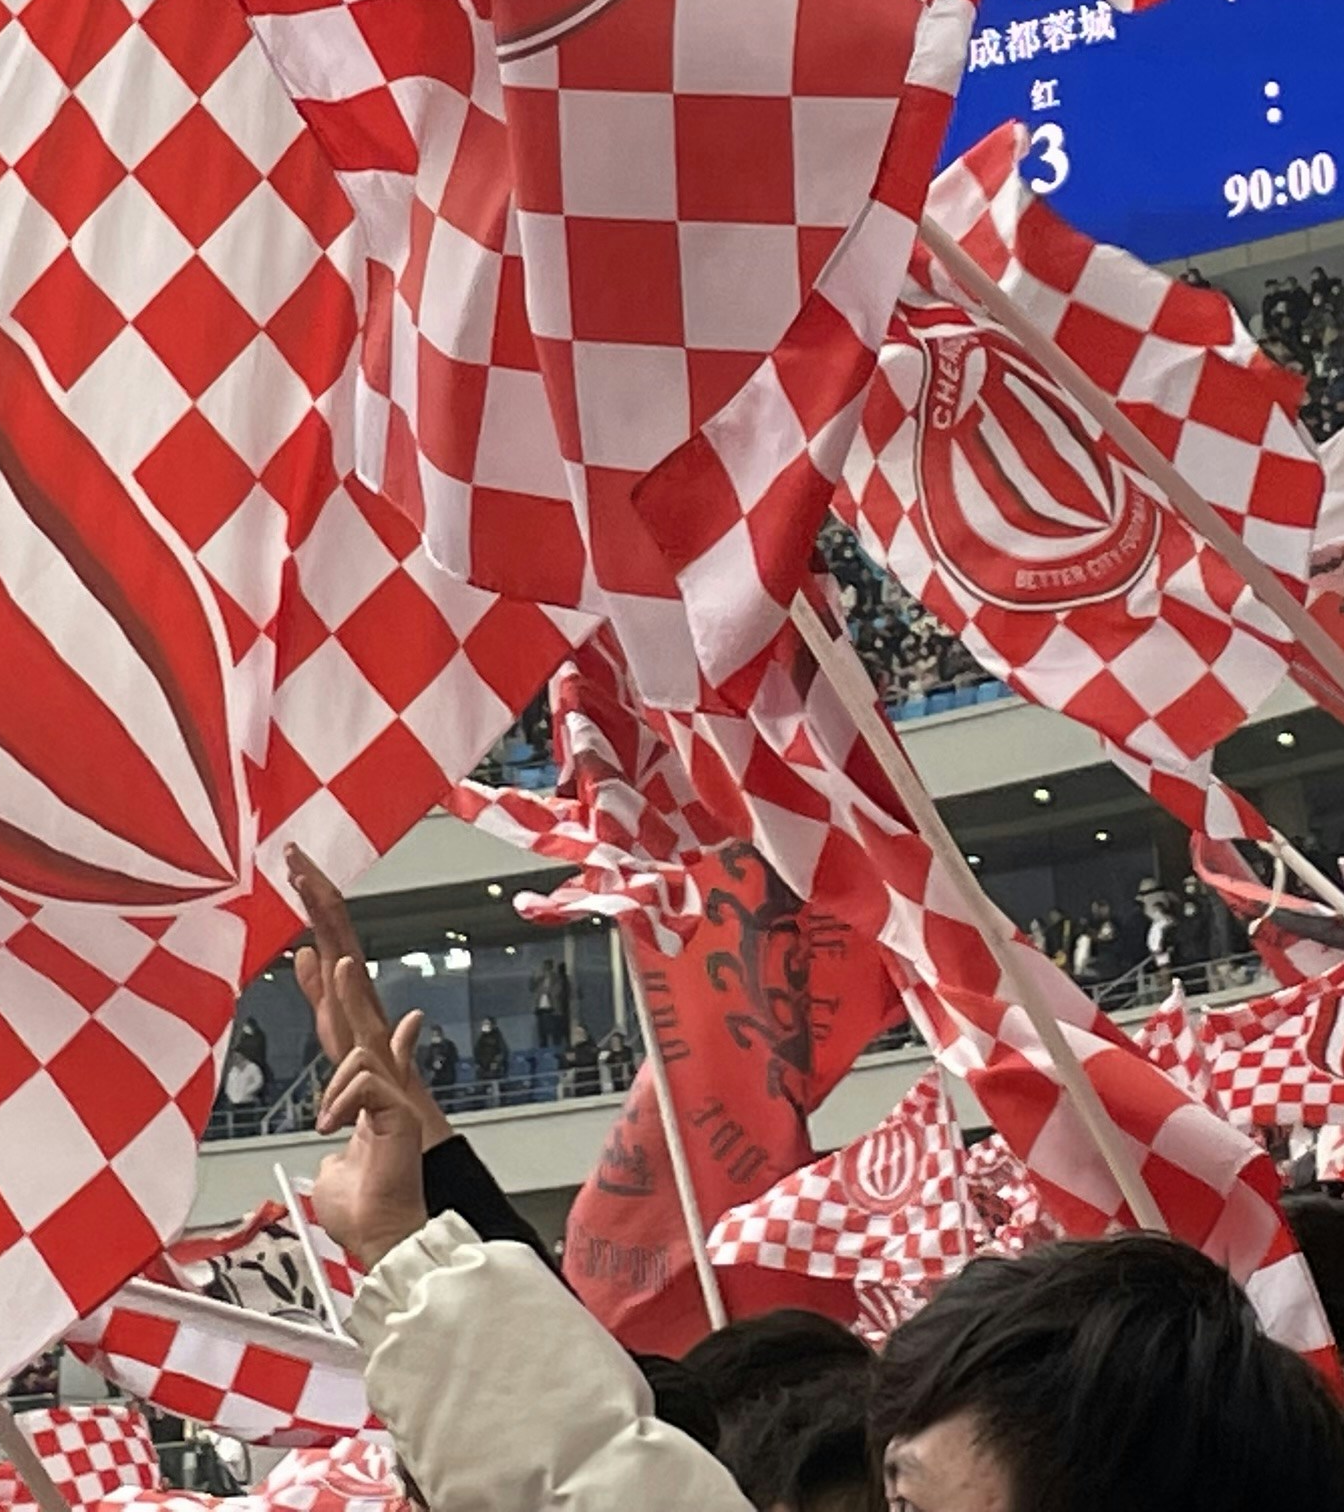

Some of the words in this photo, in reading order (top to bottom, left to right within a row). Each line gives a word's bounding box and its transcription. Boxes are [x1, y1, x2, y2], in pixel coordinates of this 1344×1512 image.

[968, 0, 1117, 73] 成都蓉城
[1030, 79, 1061, 111] 红
[1030, 122, 1070, 194] 3
[1224, 151, 1338, 218] 90:00
